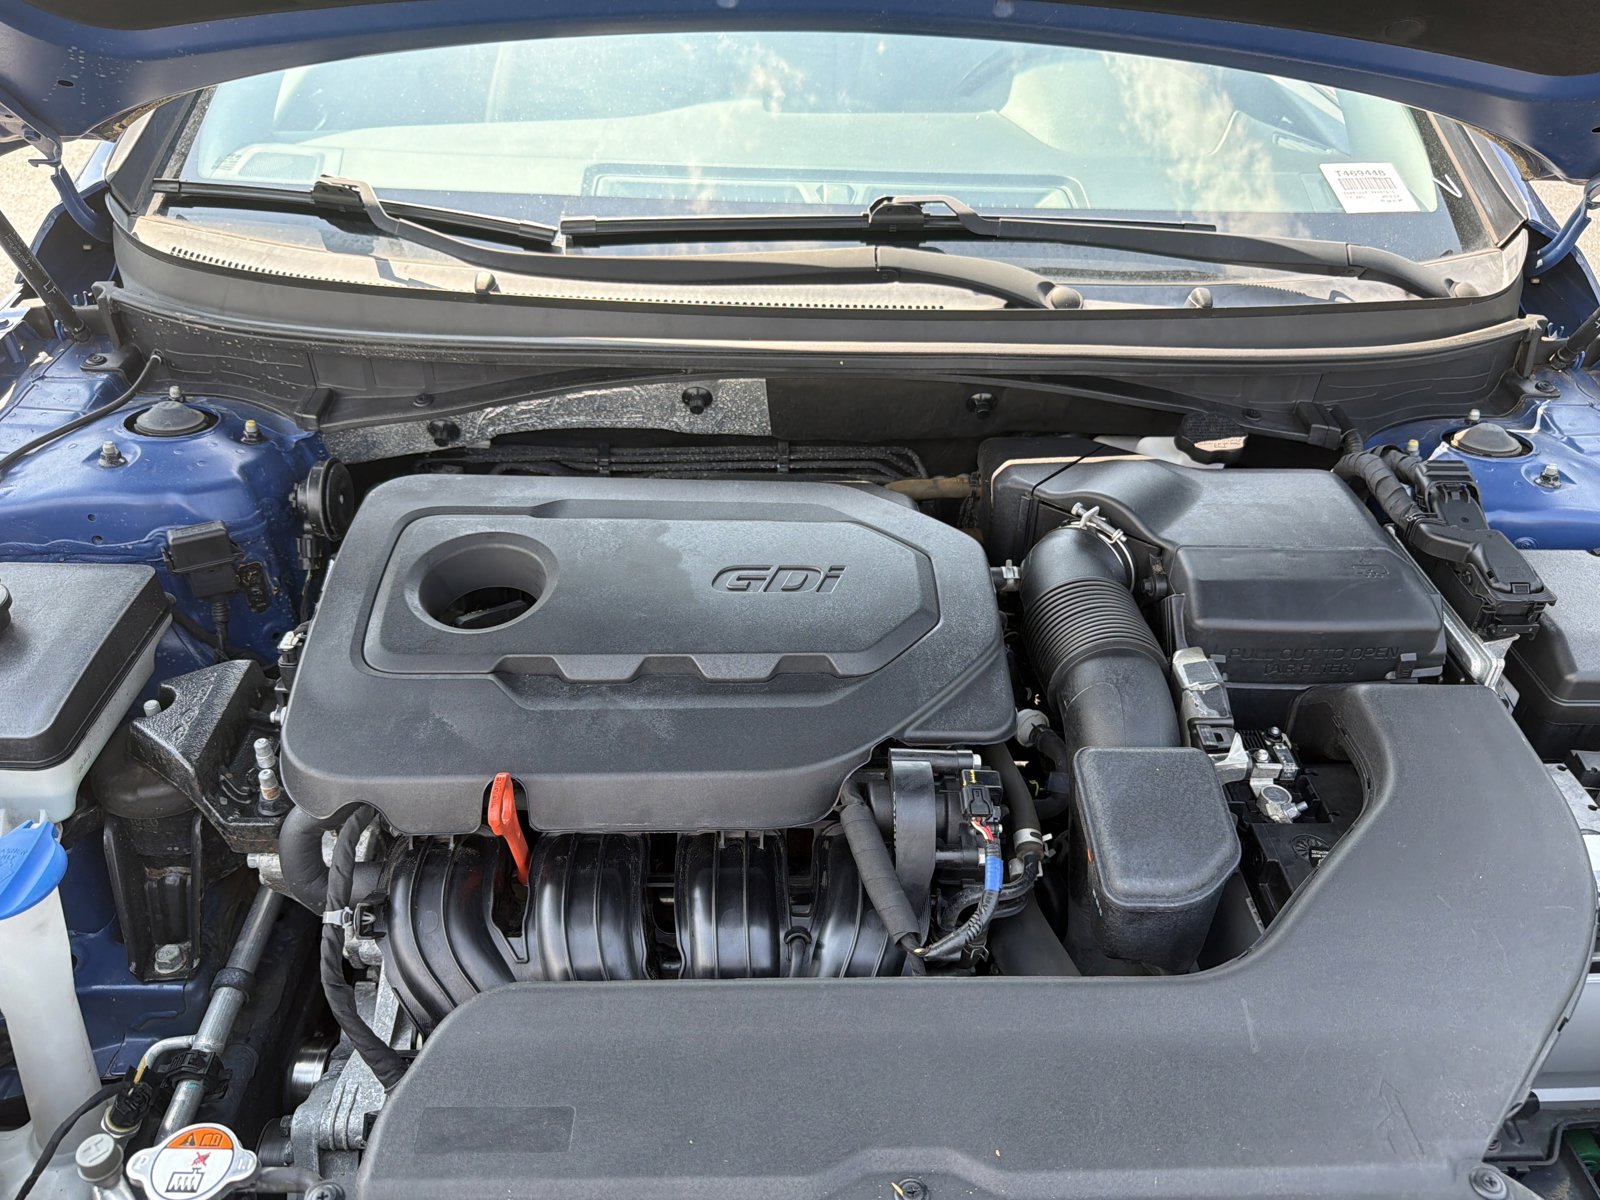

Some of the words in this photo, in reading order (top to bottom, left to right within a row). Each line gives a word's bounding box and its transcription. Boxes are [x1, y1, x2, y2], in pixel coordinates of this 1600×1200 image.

[711, 564, 847, 593] GDi
[1229, 647, 1274, 660] PULL
[1279, 648, 1319, 660] OUT
[1323, 648, 1344, 660] TO
[1350, 646, 1399, 660] OPEN
